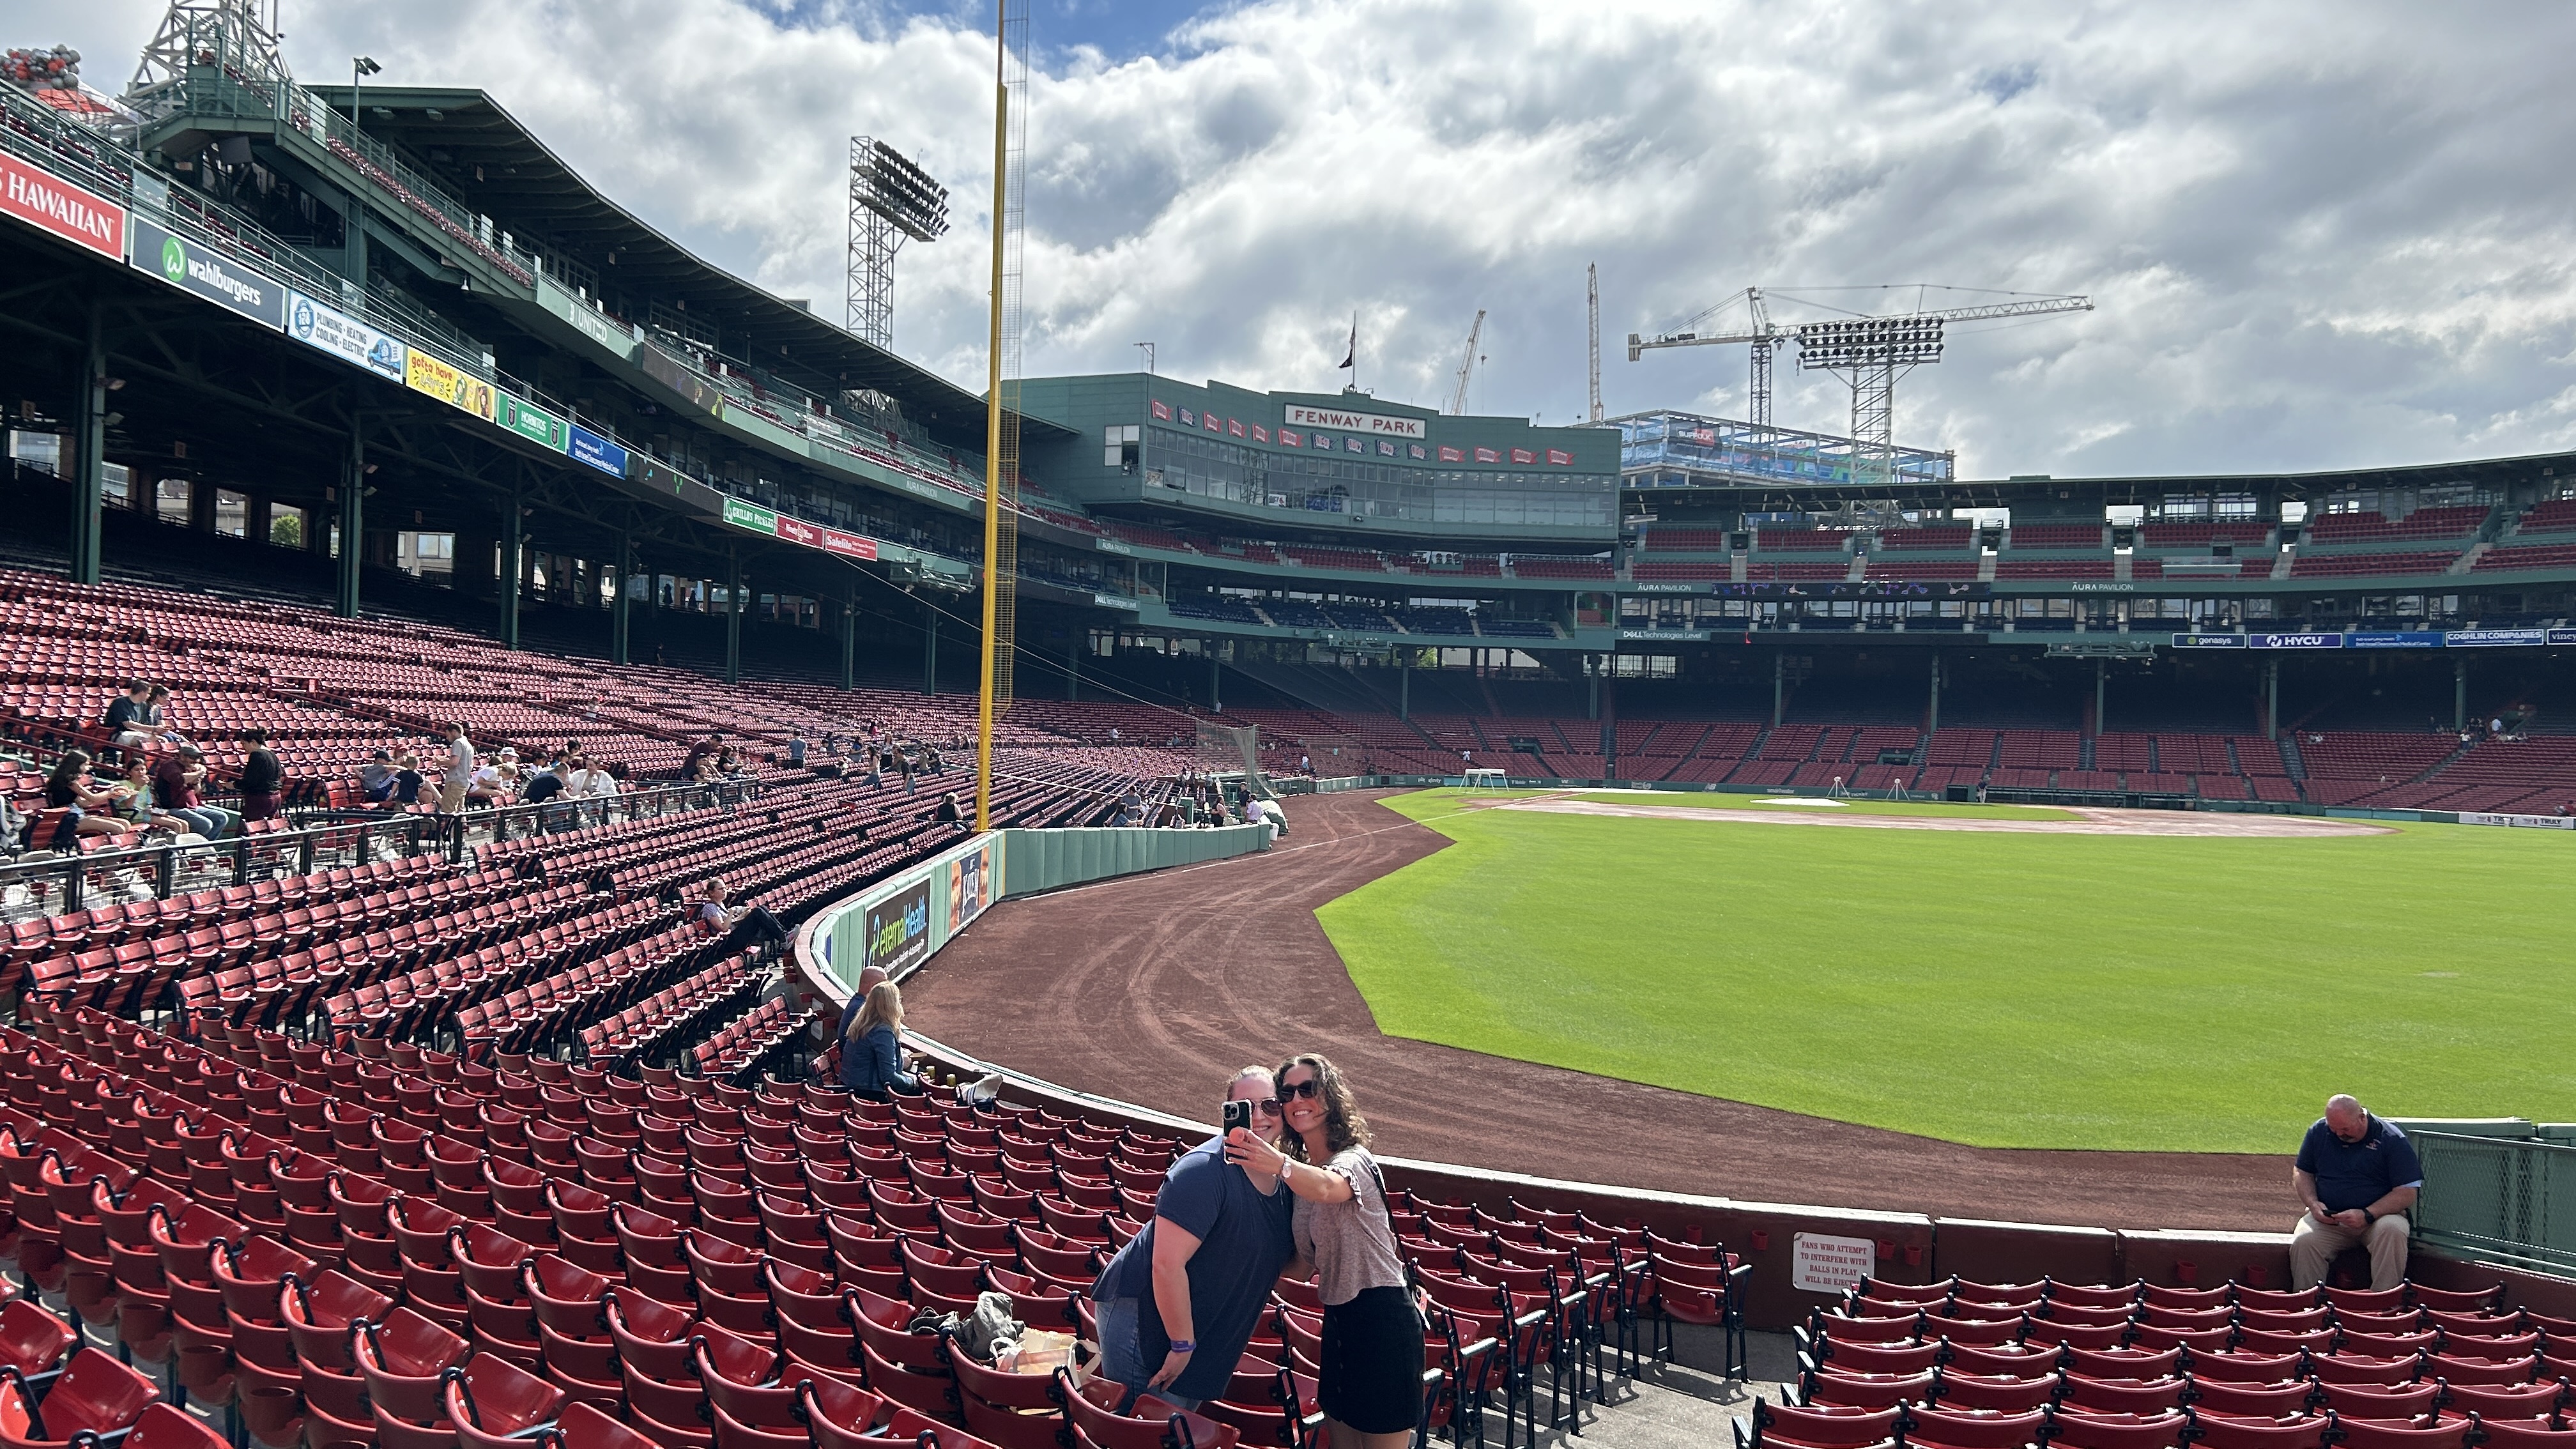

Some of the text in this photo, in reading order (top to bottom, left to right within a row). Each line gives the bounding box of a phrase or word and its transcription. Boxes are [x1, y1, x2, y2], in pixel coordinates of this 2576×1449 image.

[7, 171, 112, 243] HAWAIIAN
[187, 256, 261, 306] wahlburgers
[316, 312, 367, 345] PLUMBING HEATING
[578, 306, 607, 342] UNITED
[316, 326, 365, 358] COOLING ELECTRIC
[411, 356, 453, 381] gotta have
[521, 410, 547, 432] HORNITOS
[1295, 410, 1416, 434] FENWAY PARK
[827, 535, 852, 551] Safelite
[2198, 636, 2232, 645] genasys
[2285, 636, 2322, 646] HYCU
[1811, 1253, 1848, 1264] INTERFERE
[1820, 1243, 1835, 1251] WHO
[1837, 1245, 1867, 1255] ATTEMPT
[1805, 1275, 1821, 1284] WILL
[1809, 1264, 1830, 1273] BALLS
[1841, 1268, 1857, 1276] PLAY
[1289, 1402, 1296, 1412] H
